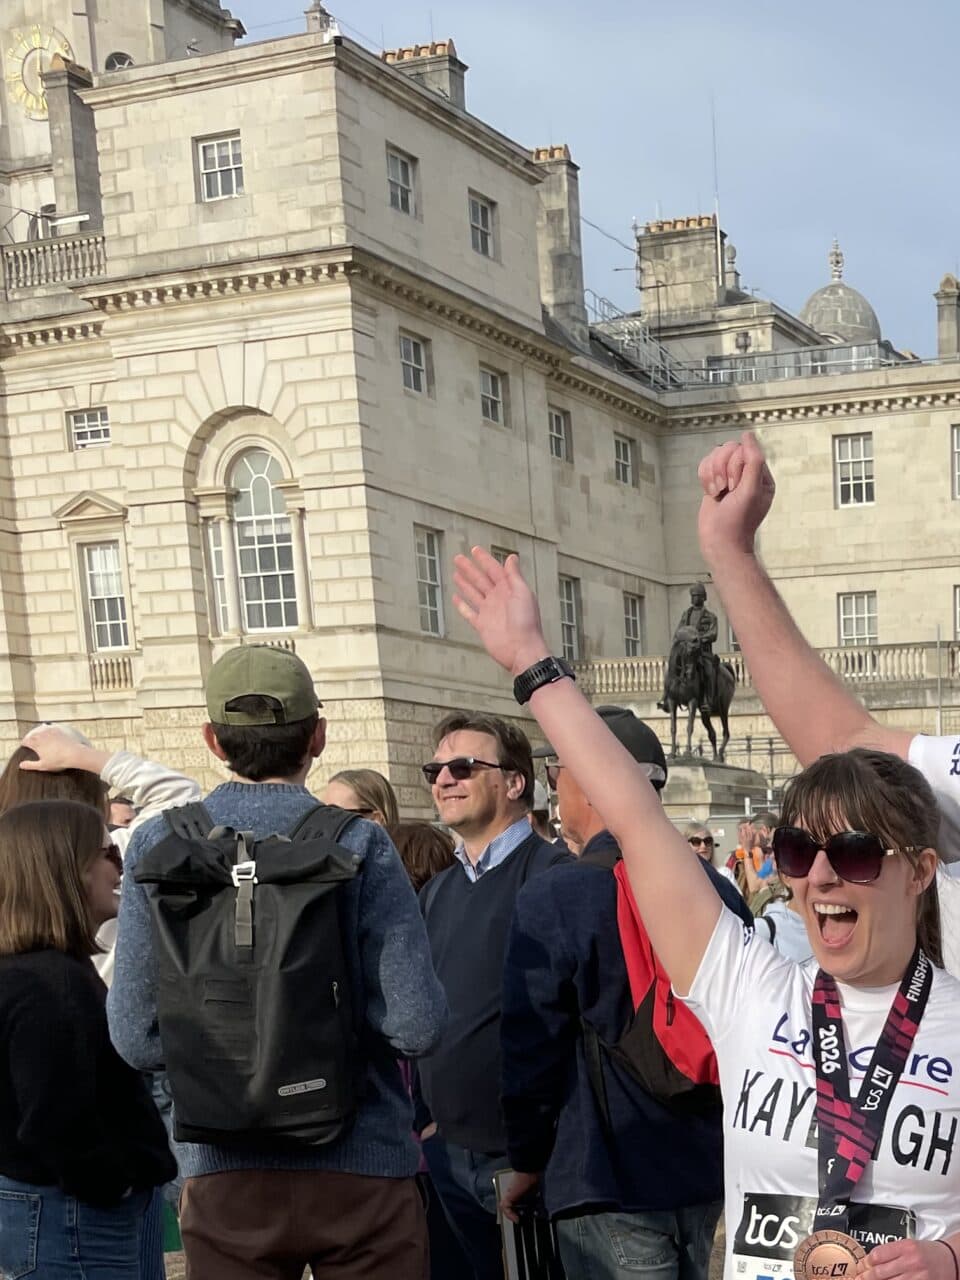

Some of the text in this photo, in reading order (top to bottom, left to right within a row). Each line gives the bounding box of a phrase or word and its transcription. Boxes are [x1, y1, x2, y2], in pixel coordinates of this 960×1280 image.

[772, 1011, 954, 1084] LaCre
[818, 1023, 841, 1075] 2026
[733, 1068, 959, 1177] KAYGH
[744, 1204, 800, 1249] tcs
[850, 1228, 904, 1246] LTANCY
